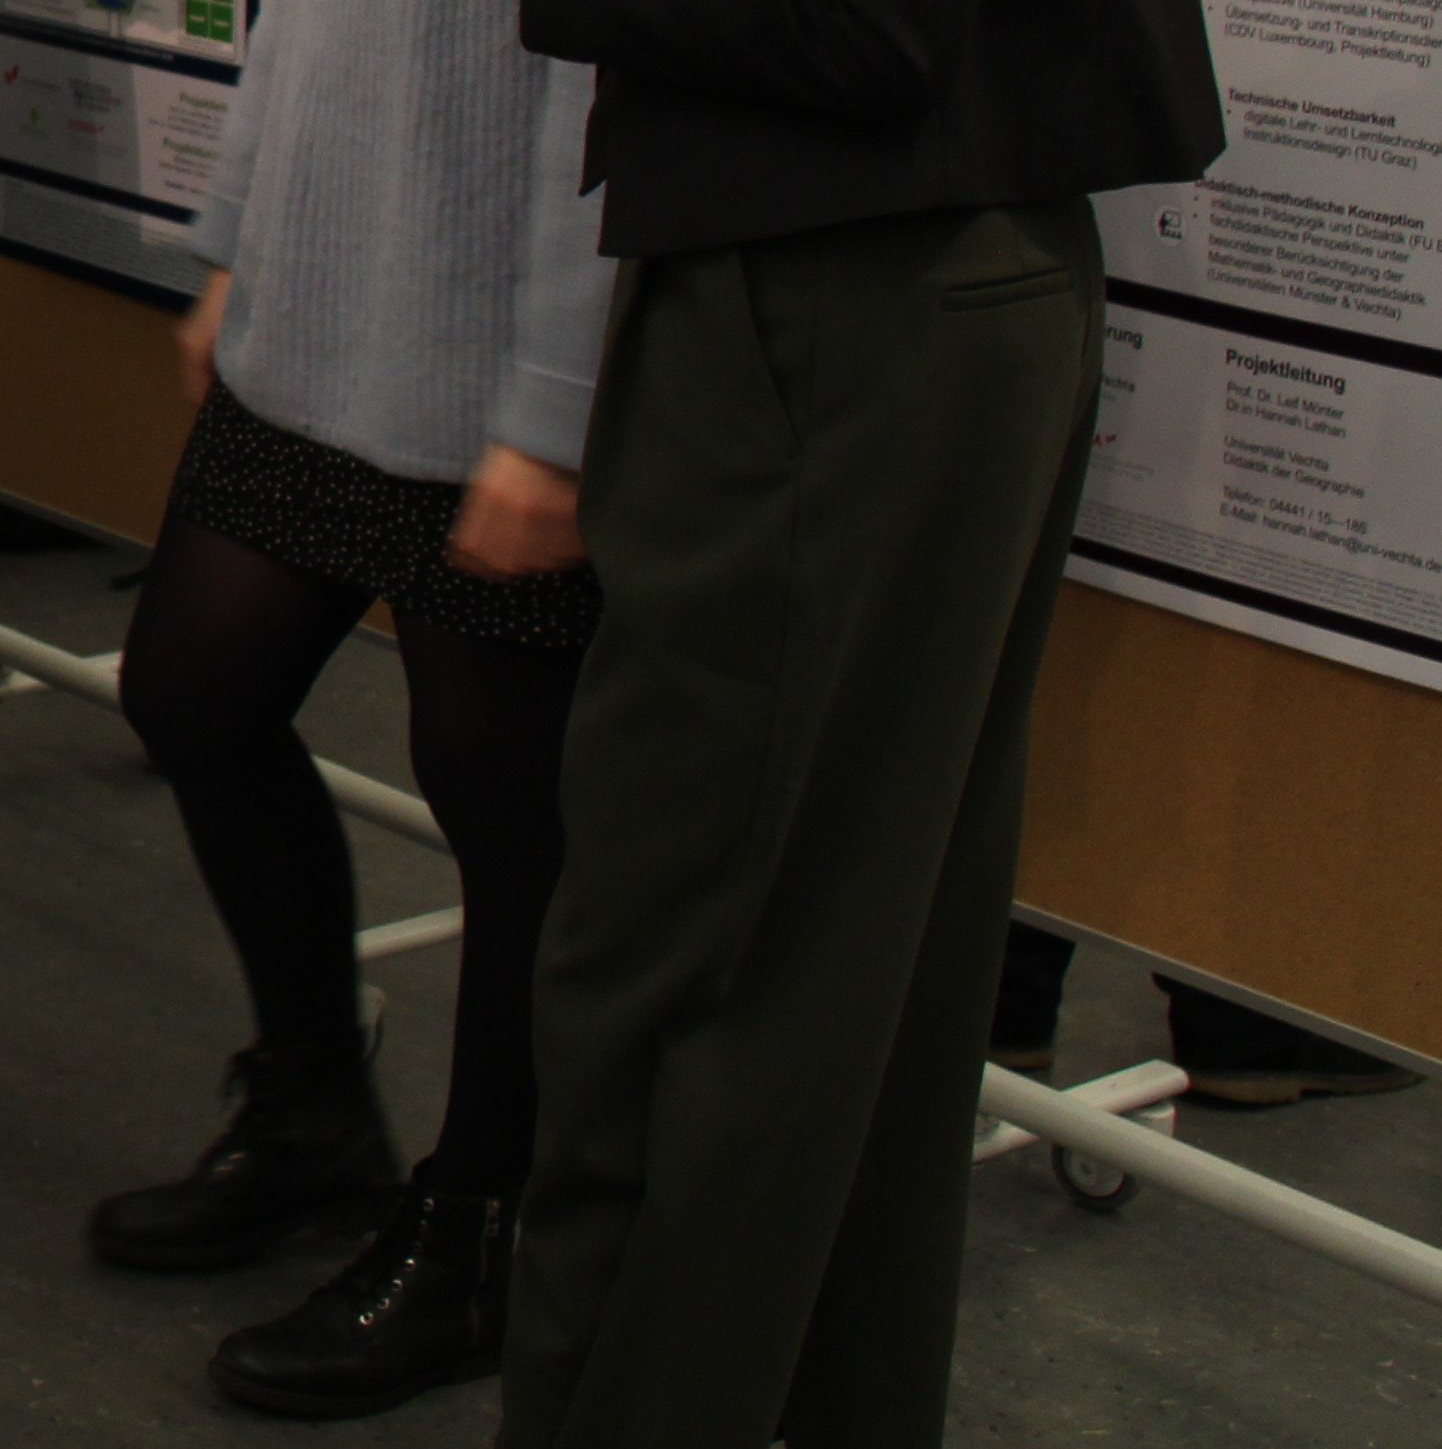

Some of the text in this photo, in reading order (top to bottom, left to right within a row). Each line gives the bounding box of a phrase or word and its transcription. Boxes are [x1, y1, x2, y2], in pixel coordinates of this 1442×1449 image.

[1228, 88, 1396, 128] Technische Umsetzbarkeit
[1225, 348, 1347, 396] Projektleitung
